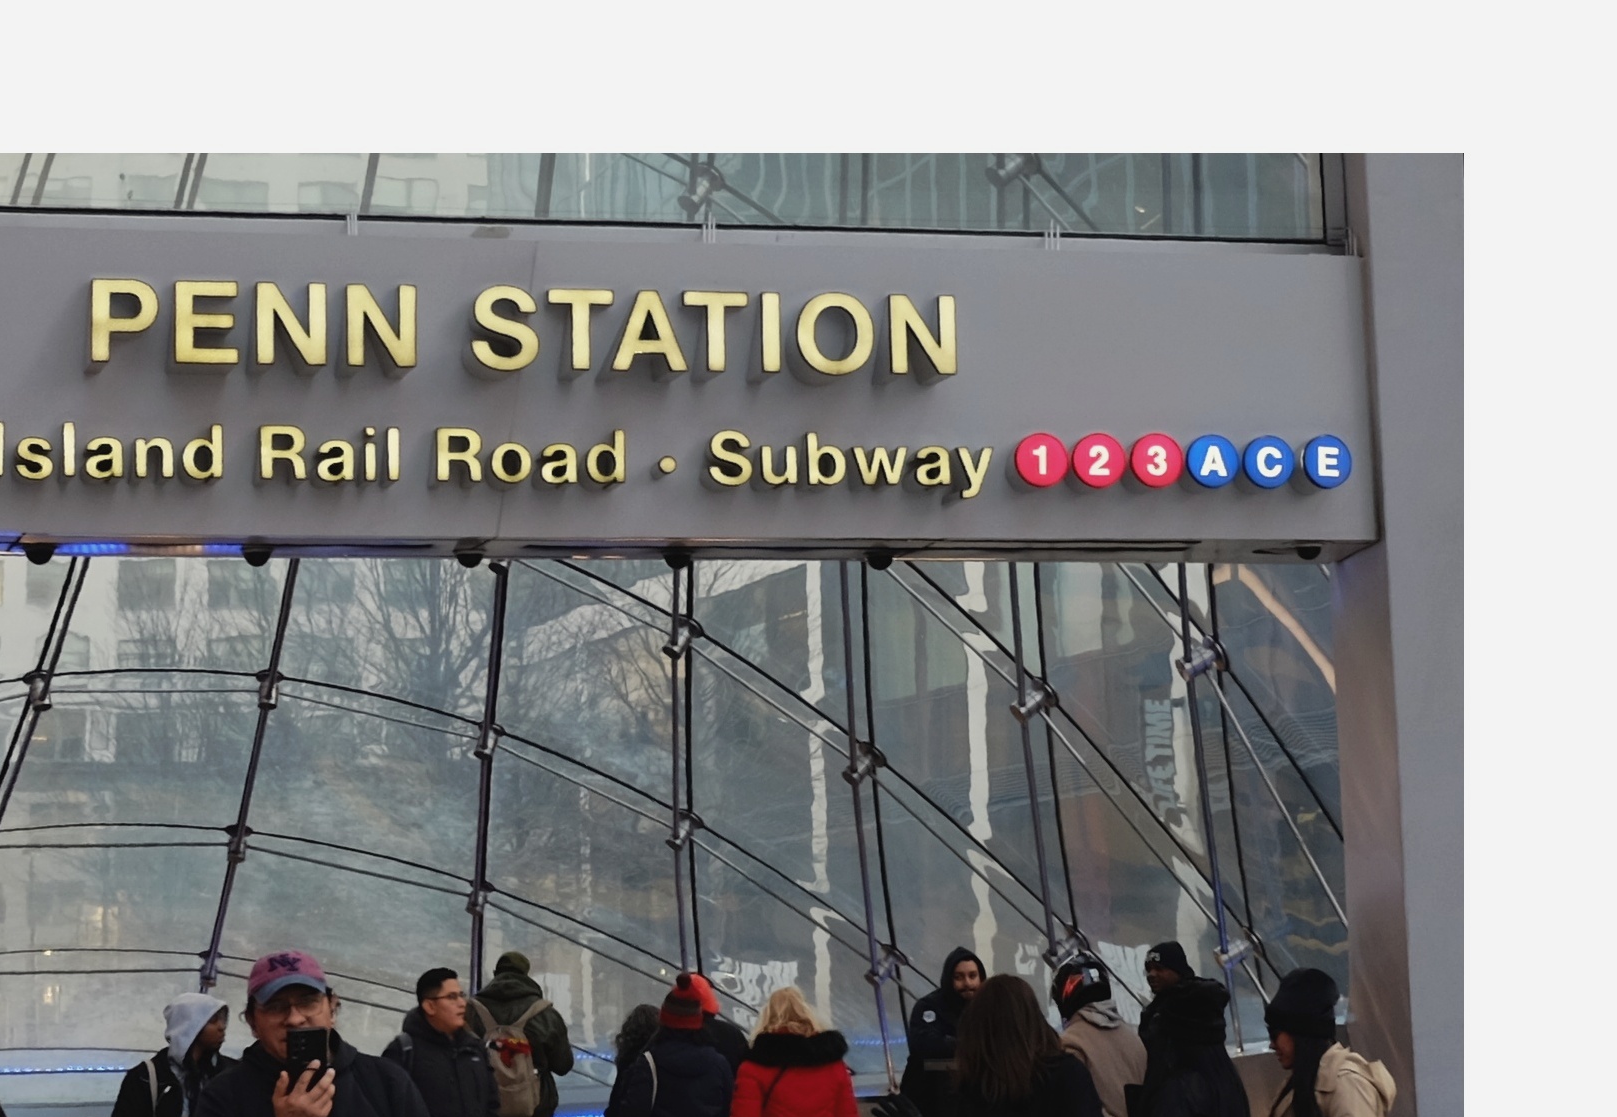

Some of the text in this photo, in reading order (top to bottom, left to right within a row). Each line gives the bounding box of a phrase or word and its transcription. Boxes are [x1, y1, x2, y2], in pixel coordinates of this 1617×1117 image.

[90, 278, 958, 376] PENN STATION
[259, 424, 401, 482] Rail
[436, 426, 626, 485] Road
[708, 429, 994, 499] Subway
[268, 953, 302, 973] NY
